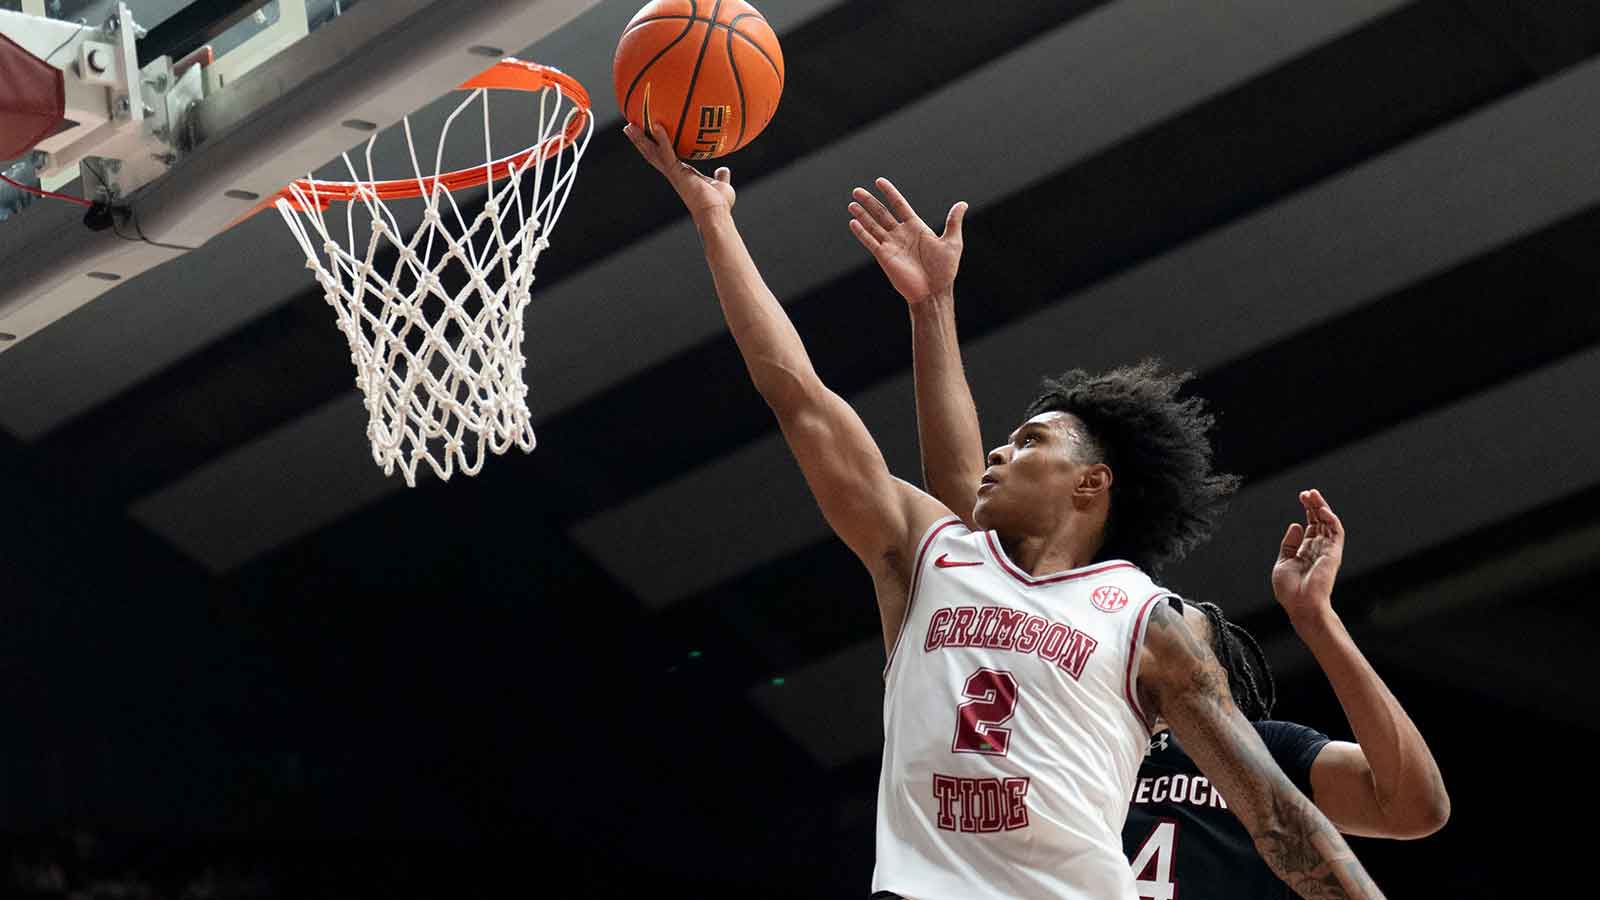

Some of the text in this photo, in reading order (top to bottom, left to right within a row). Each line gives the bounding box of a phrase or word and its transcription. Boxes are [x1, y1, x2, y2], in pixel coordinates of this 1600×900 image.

[1091, 587, 1127, 611] SEC
[924, 606, 1097, 681] CRIMSON
[952, 667, 1018, 757] 2
[933, 773, 1030, 832] TIDE
[1132, 774, 1228, 809] ECOCK
[1131, 819, 1177, 900] 4
